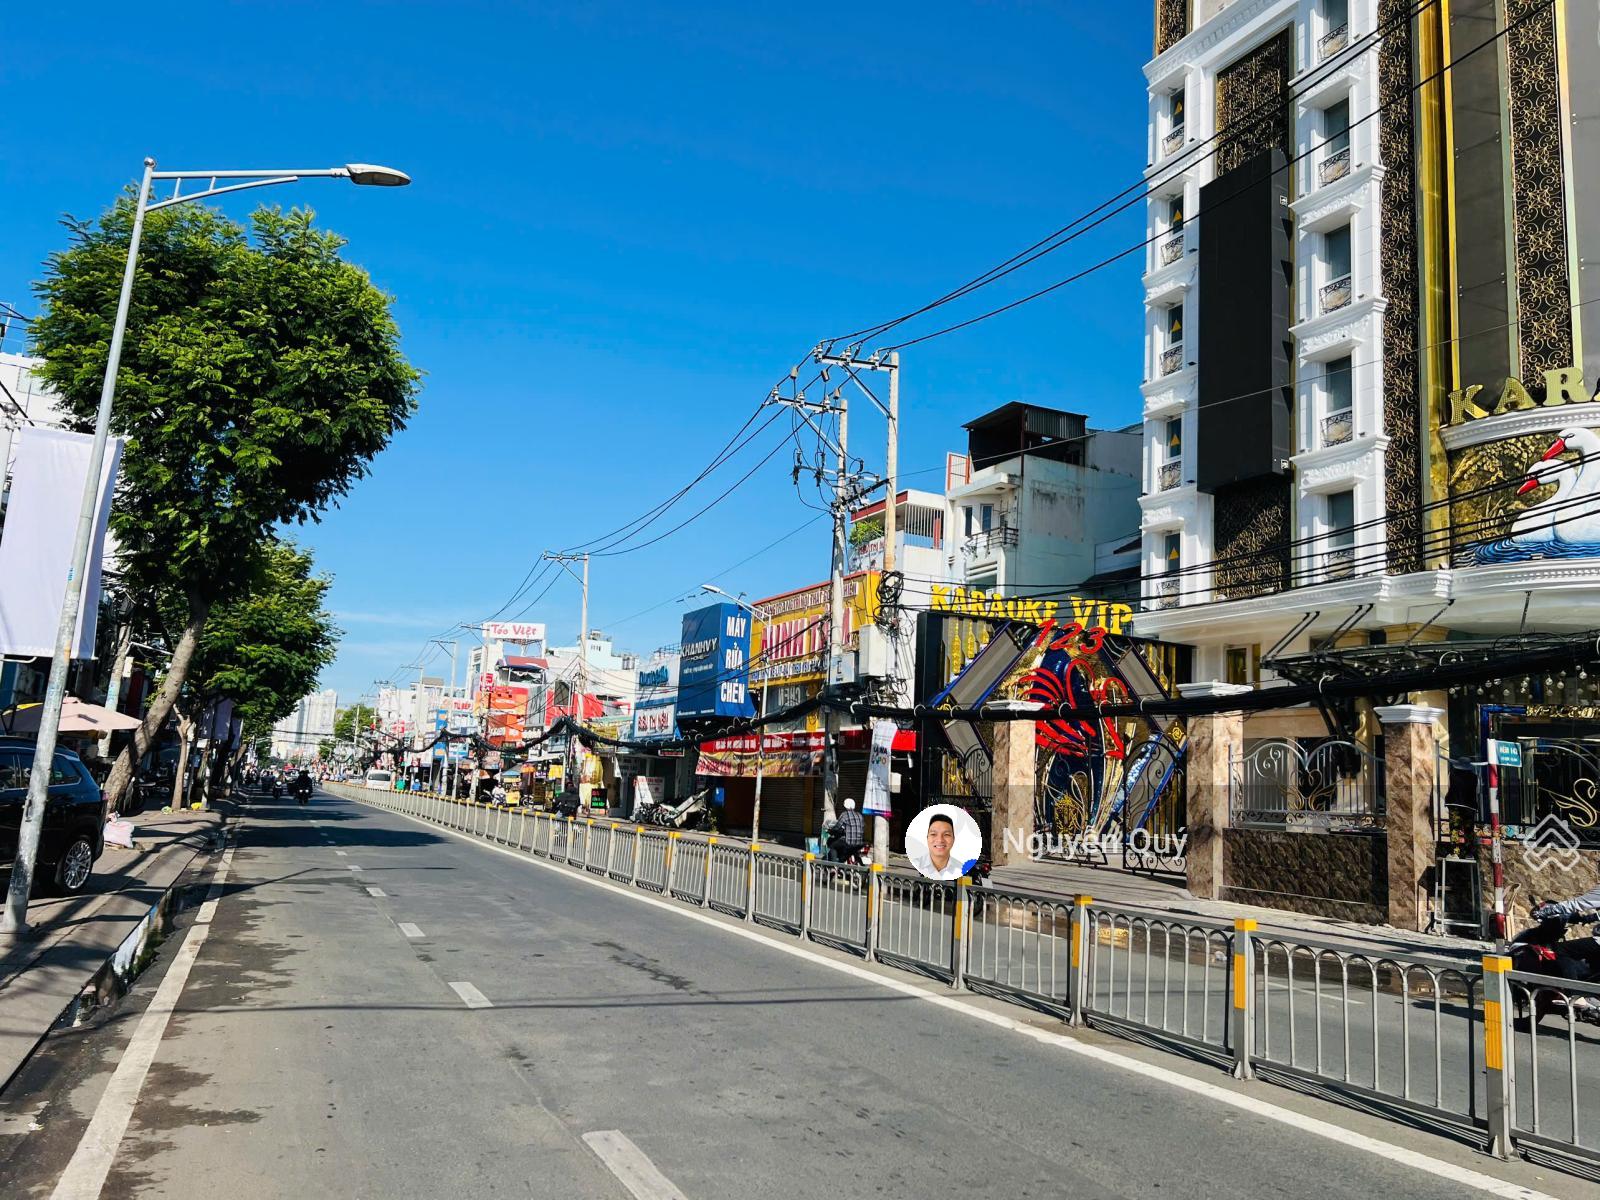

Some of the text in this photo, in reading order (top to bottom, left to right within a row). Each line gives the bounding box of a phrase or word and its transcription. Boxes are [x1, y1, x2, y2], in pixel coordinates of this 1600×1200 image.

[1448, 367, 1600, 425] KAR
[726, 613, 746, 638] MÁY
[930, 585, 1133, 635] KARAOKE VIP
[1035, 617, 1106, 655] 123
[725, 642, 743, 670] RỬA
[721, 679, 745, 704] CHÉN
